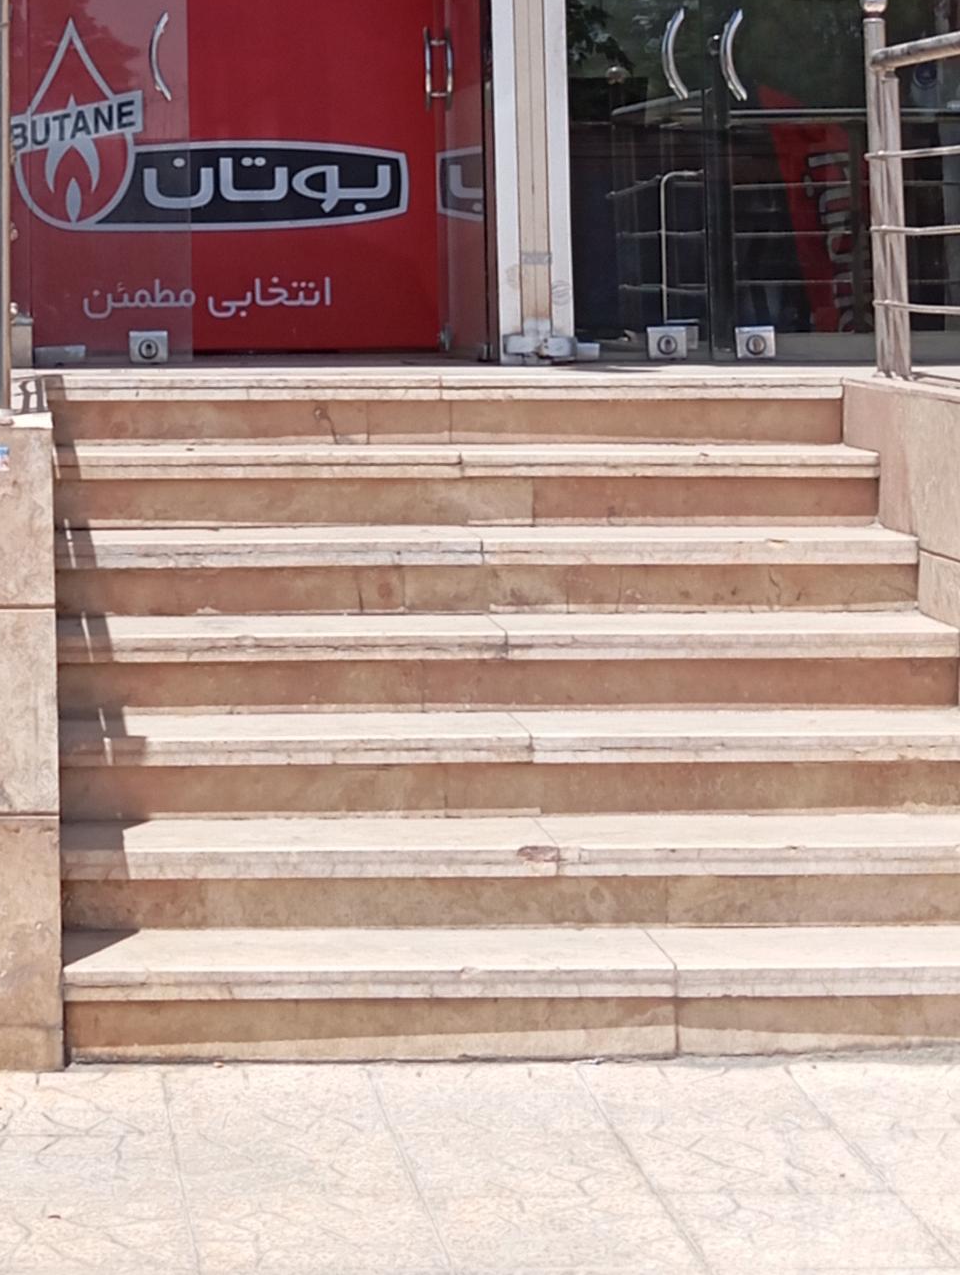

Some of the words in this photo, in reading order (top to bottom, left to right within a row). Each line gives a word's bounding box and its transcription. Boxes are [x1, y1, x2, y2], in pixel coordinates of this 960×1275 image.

[11, 100, 135, 150] BUTANE
[142, 155, 391, 214] بوتان
[83, 278, 196, 319] مطمئن
[207, 276, 332, 317] انتخابی
